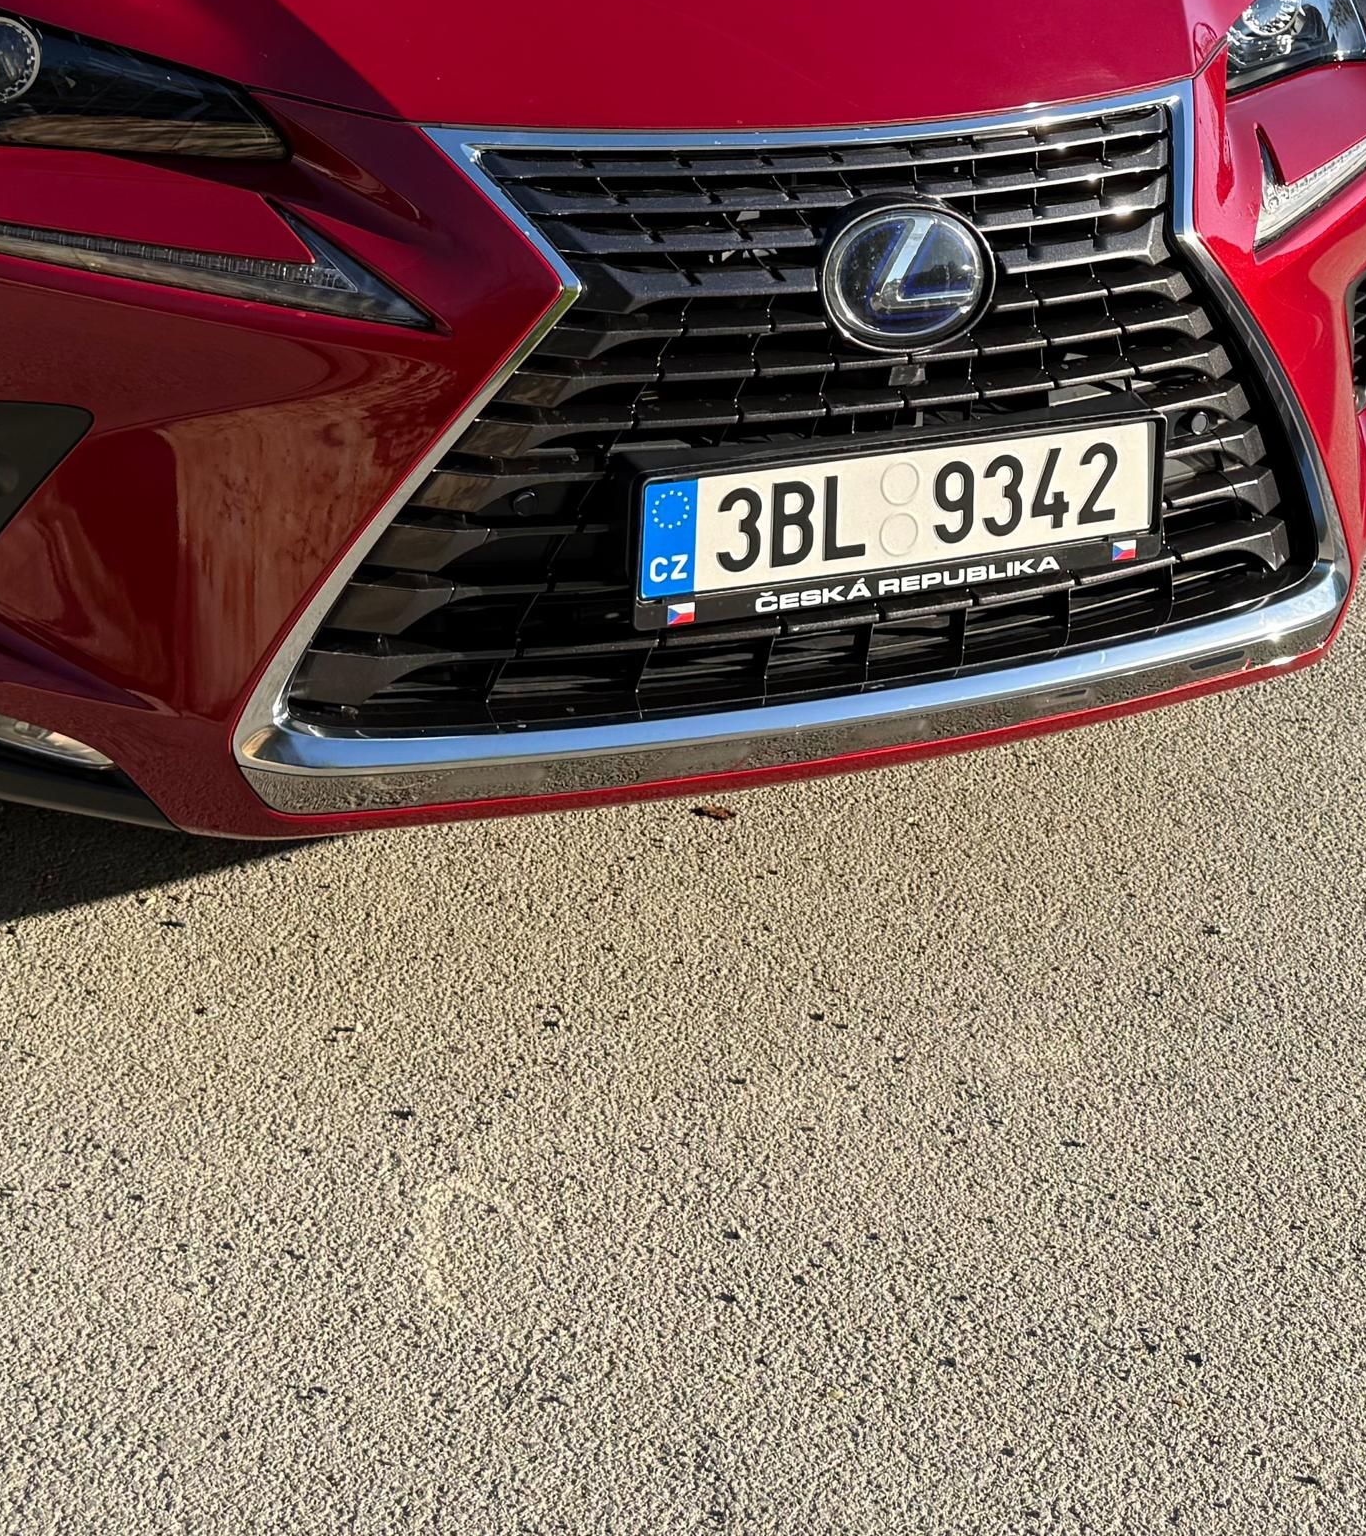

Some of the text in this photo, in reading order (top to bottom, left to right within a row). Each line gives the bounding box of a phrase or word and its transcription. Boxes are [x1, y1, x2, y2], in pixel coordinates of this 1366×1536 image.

[716, 442, 1118, 573] 3BL 9342
[649, 554, 688, 583] CZ
[754, 555, 1061, 613] ČESKÁ REPUBLIKA
